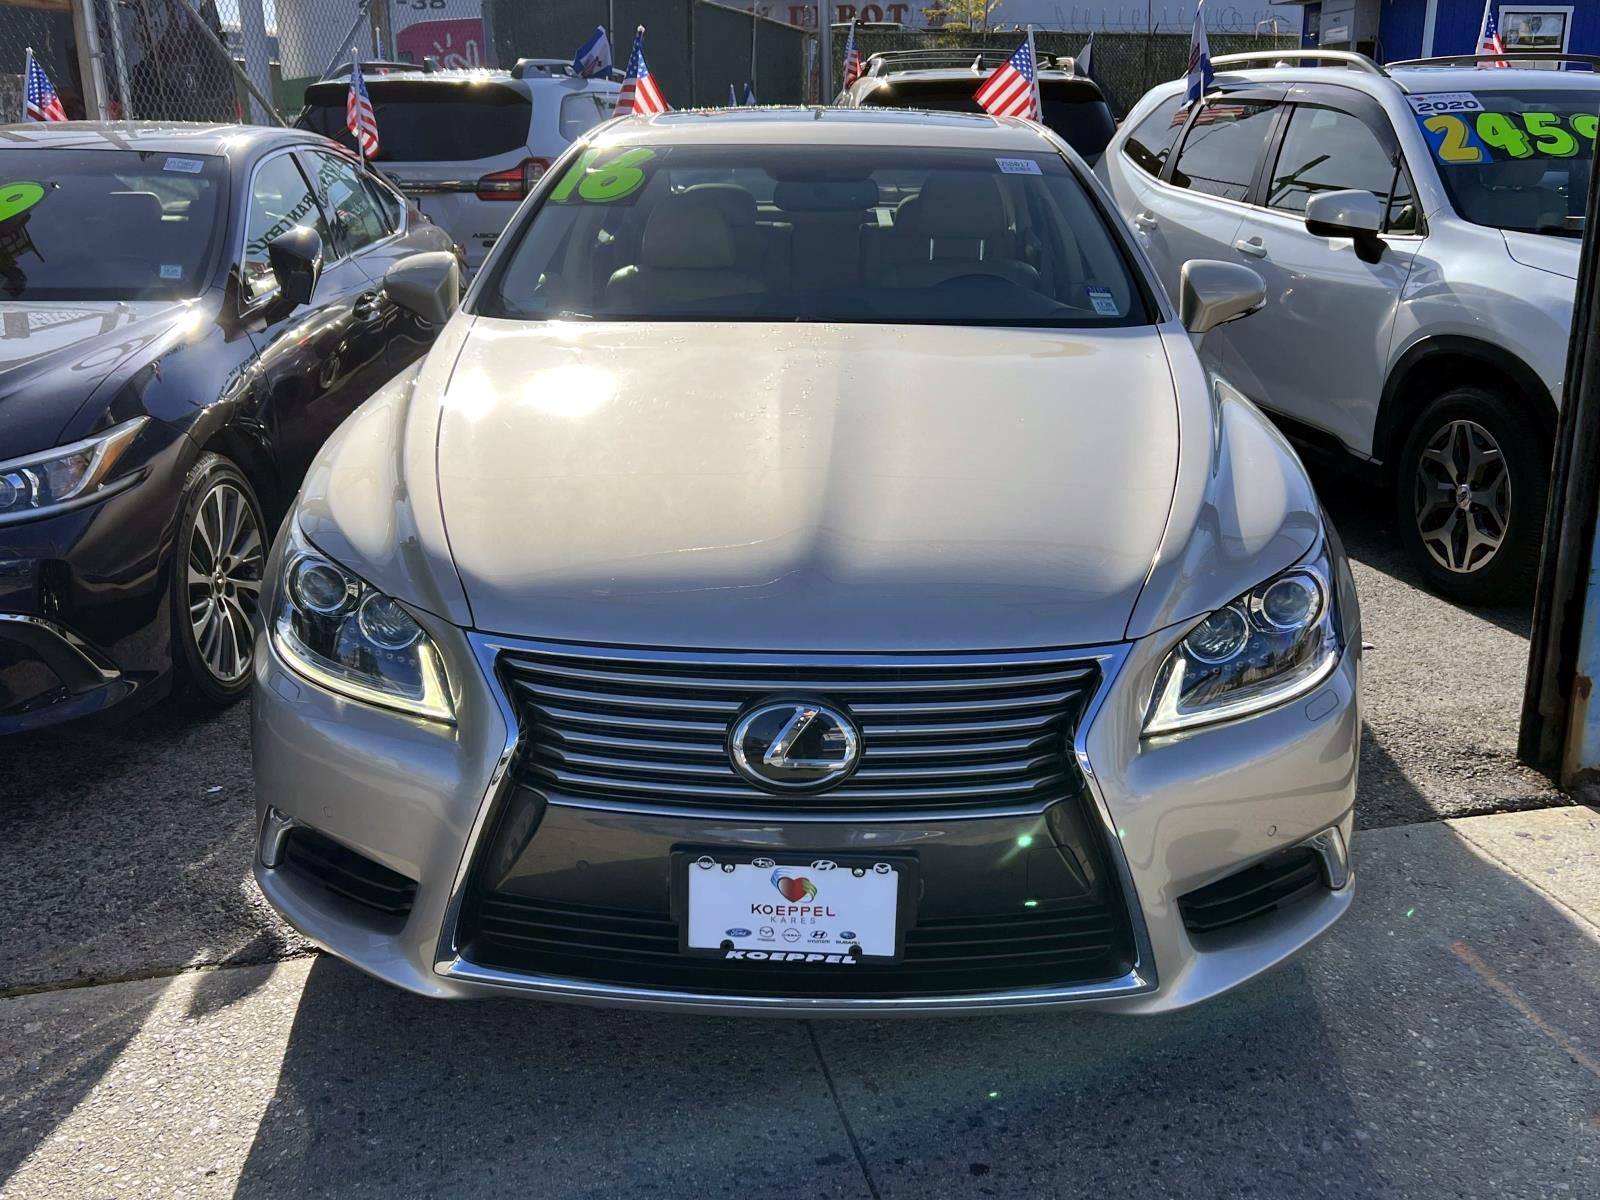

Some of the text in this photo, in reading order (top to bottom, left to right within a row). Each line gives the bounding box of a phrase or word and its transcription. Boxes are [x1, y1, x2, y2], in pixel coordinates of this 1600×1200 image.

[1417, 100, 1479, 113] 2020
[548, 147, 657, 204] 16
[751, 904, 836, 917] KOEPPEL
[770, 916, 817, 925] KARES
[725, 951, 857, 964] KOEPPEL
